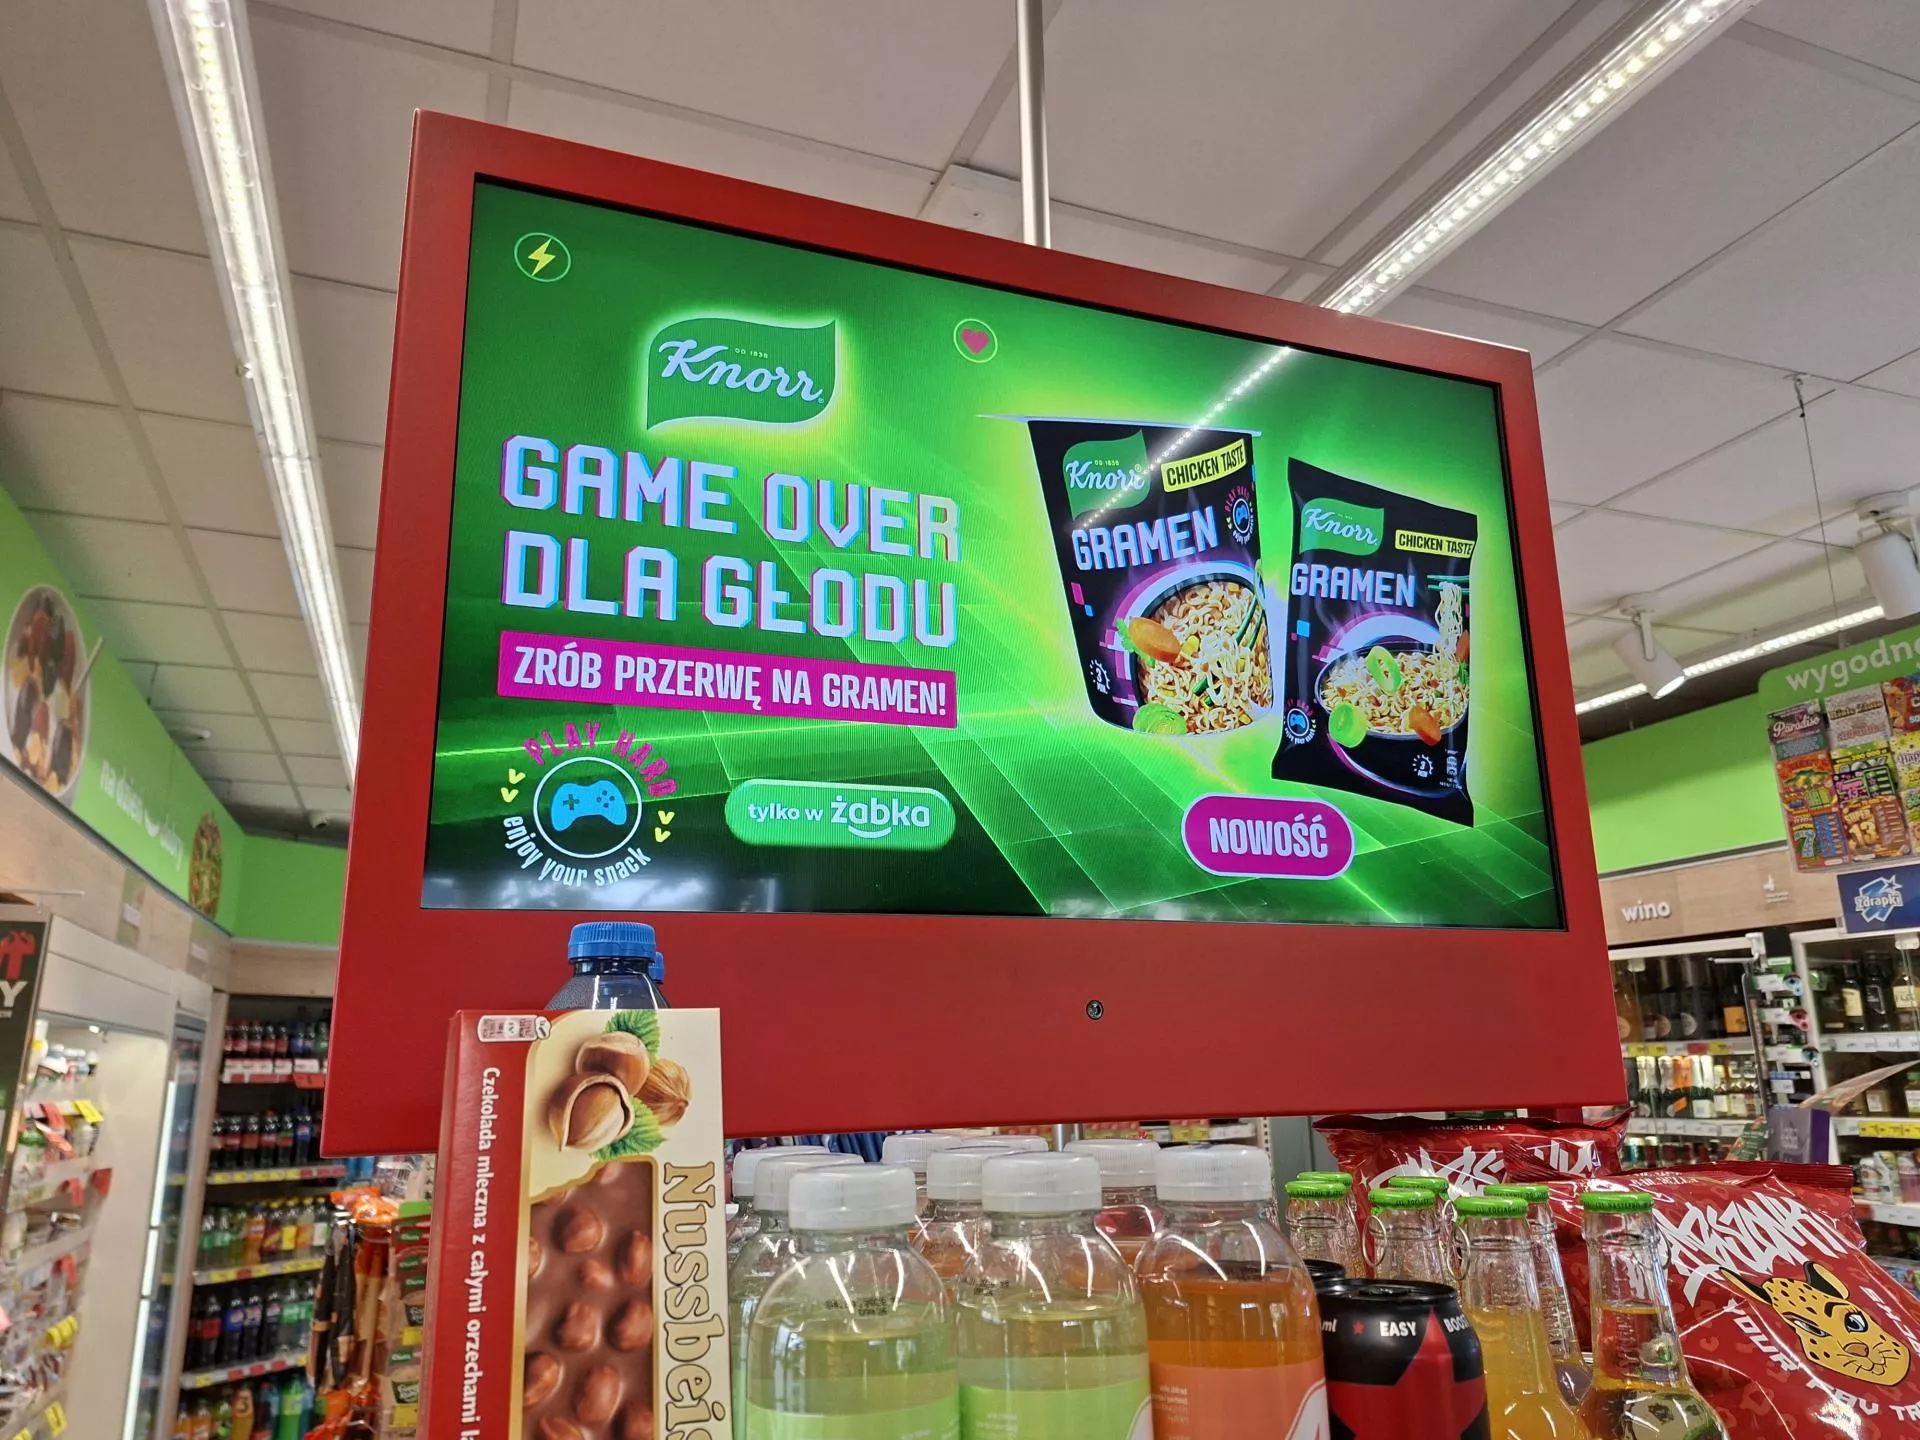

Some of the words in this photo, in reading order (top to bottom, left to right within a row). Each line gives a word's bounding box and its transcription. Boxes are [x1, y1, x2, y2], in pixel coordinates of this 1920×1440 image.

[658, 339, 824, 402] Knorr
[1065, 460, 1145, 490] Knorr
[1166, 456, 1219, 487] CHICKEN
[1220, 443, 1245, 469] TASTE
[500, 434, 739, 535] GAME
[763, 472, 961, 562] OVER
[1304, 508, 1378, 546] Knorr
[1071, 506, 1219, 571] GRAMEN
[1398, 533, 1443, 552] CHICKEN
[1445, 540, 1474, 556] TASTE
[501, 529, 679, 622] DLA
[702, 554, 958, 649] GŁODU
[1291, 563, 1416, 608] GRAMEN
[513, 641, 602, 689] ZRÓB
[615, 655, 763, 711] PRZERWĘ
[771, 669, 812, 706] NA
[822, 671, 947, 716] GRAMEN!
[523, 721, 601, 766] PLAY
[612, 729, 678, 797] HARD
[747, 803, 801, 823] tylko
[805, 807, 824, 822] w
[830, 794, 931, 832] żabka
[1208, 812, 1329, 859] NOWOŚĆ
[503, 816, 544, 870] enjoy
[538, 857, 588, 887] your
[593, 846, 652, 887] snack
[1621, 900, 1671, 923] wino
[1856, 891, 1902, 910] zdrapki
[478, 1066, 501, 1151] Czekolada
[472, 1154, 496, 1230] mleczna
[471, 1232, 487, 1246] z
[463, 1250, 488, 1314] całymi
[1379, 1320, 1417, 1337] EASY
[1722, 1298, 1801, 1372] YOUR
[462, 1318, 484, 1425] orzechami
